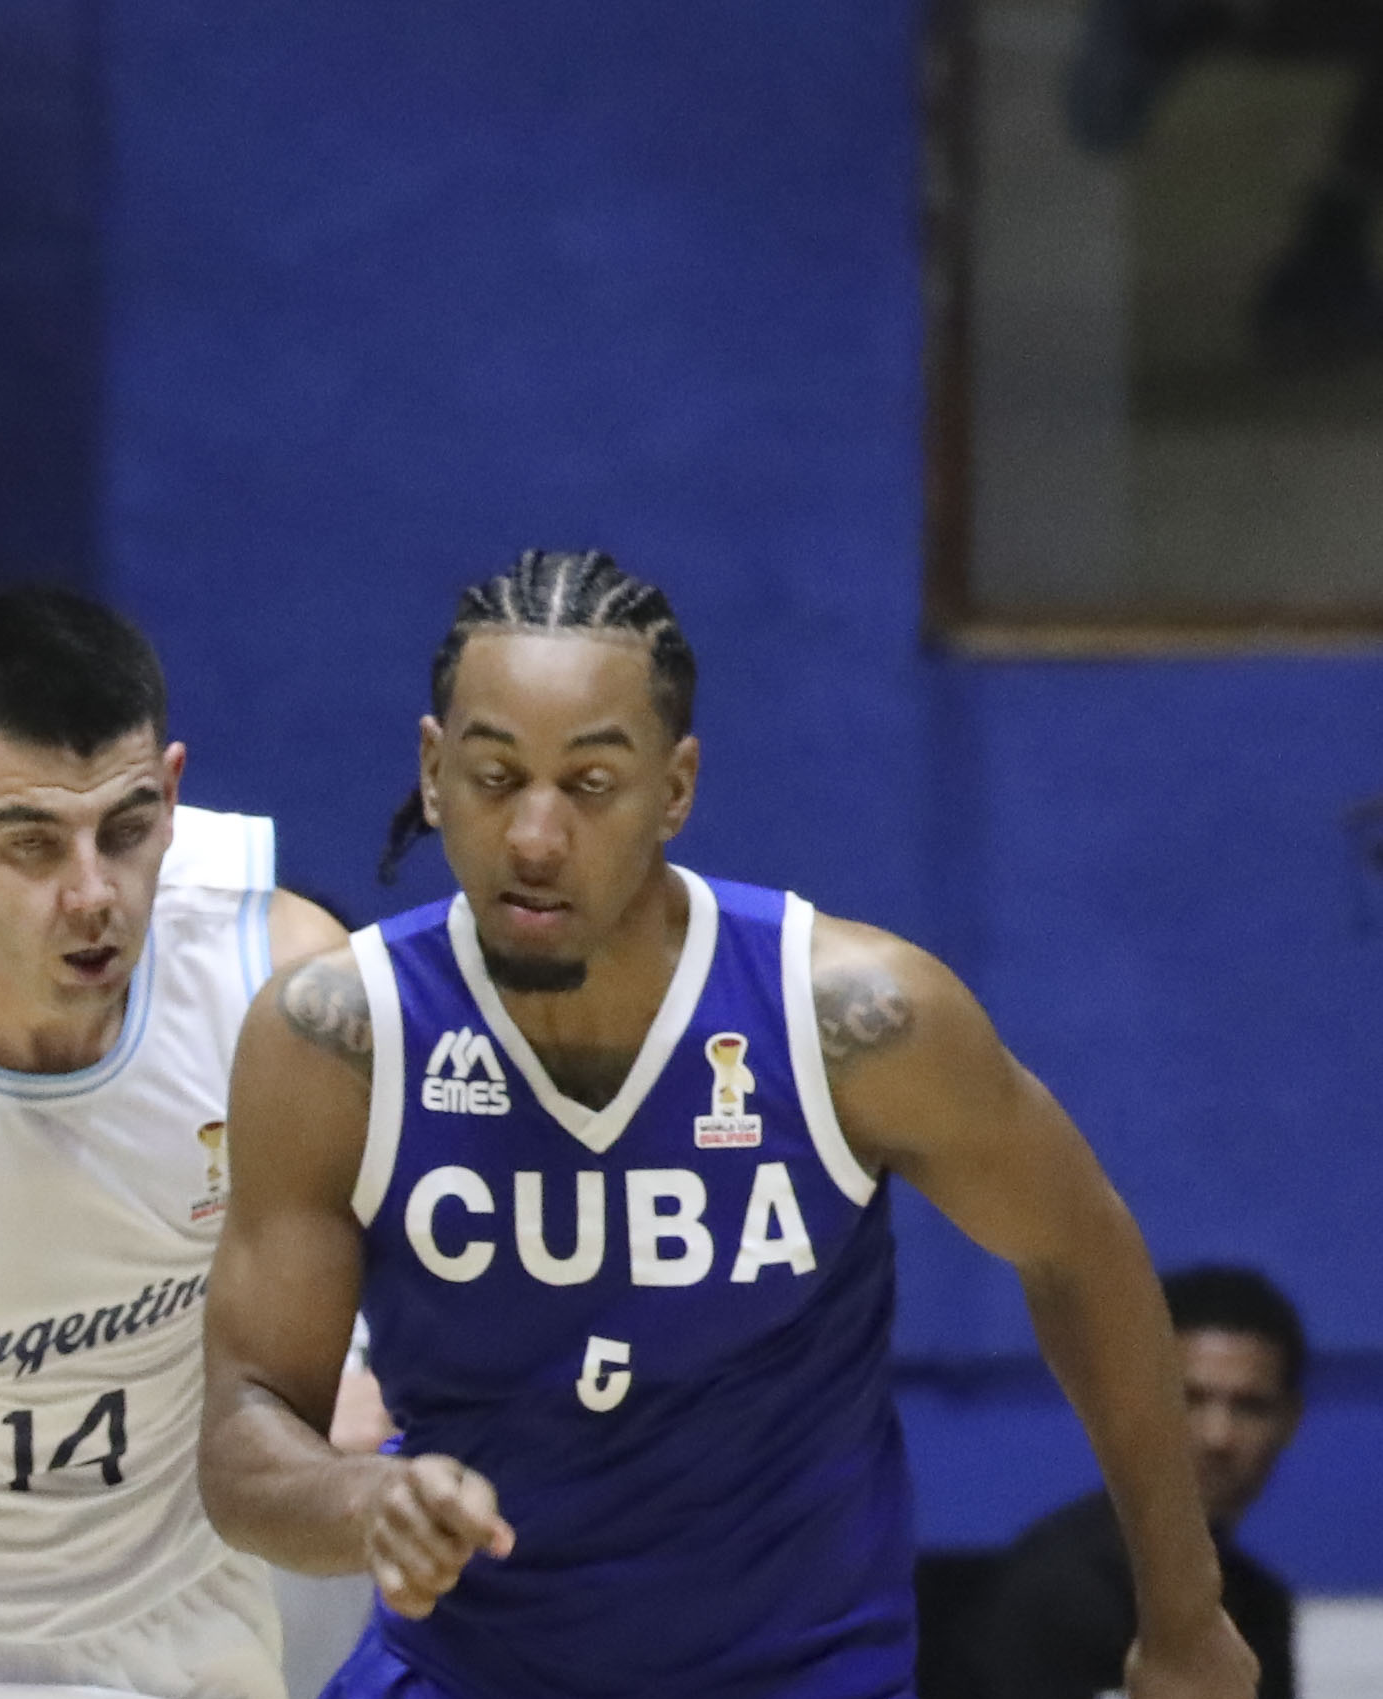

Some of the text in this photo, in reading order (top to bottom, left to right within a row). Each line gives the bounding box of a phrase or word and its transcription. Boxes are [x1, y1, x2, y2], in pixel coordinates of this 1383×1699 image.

[422, 1078, 511, 1116] EMES
[404, 1161, 817, 1287] CUBA
[1, 1388, 130, 1492] 14
